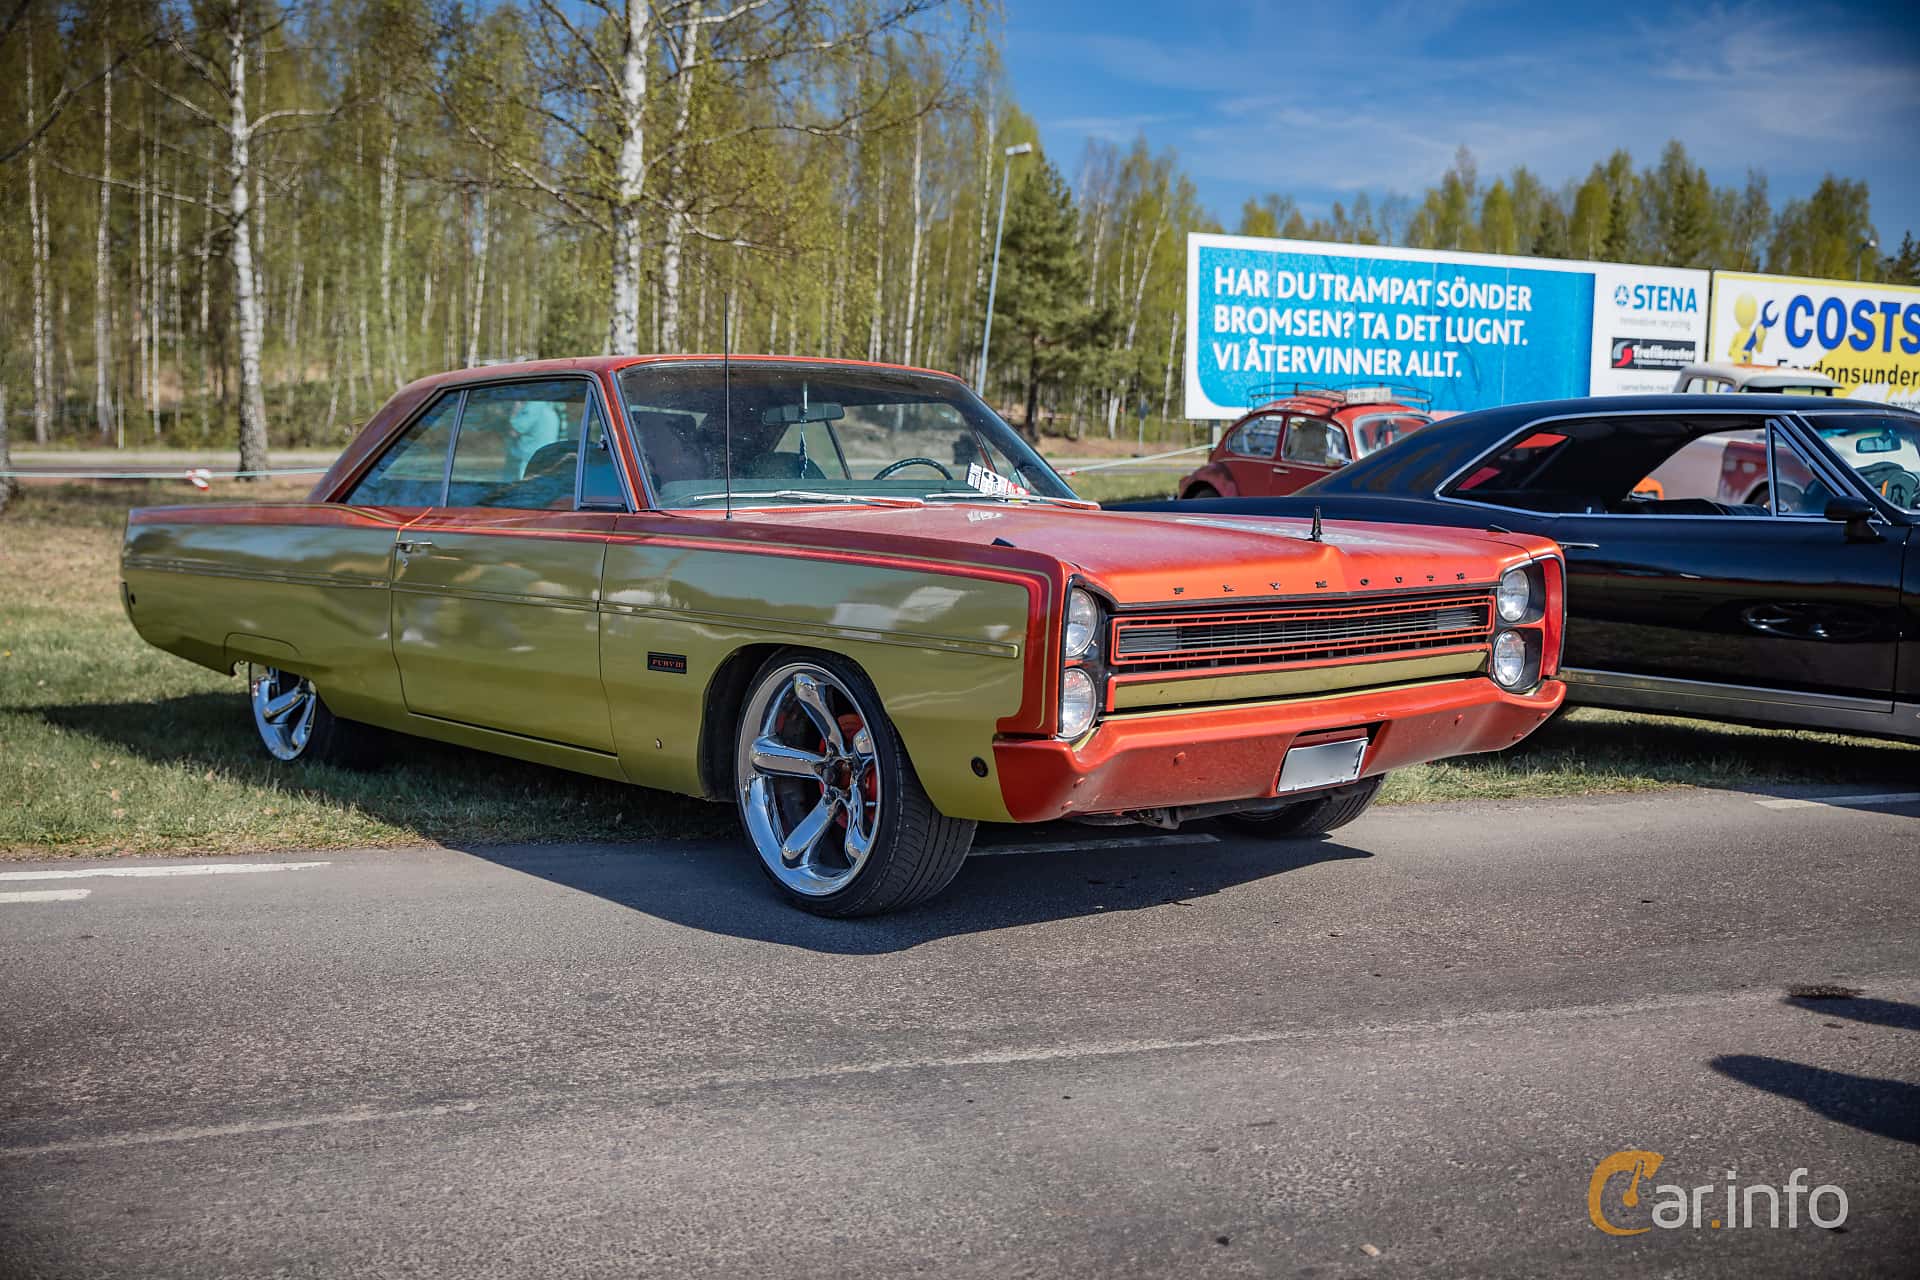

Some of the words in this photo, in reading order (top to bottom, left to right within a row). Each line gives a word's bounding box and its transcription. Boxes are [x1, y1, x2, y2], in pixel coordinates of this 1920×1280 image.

[1214, 267, 1270, 297] HAR
[1277, 271, 1316, 300] DU
[1319, 273, 1432, 304] TRAMPAT
[1436, 277, 1532, 312] SÖNDER
[1633, 284, 1697, 313] STENA
[1214, 305, 1354, 338] BROMSEN?
[1359, 313, 1390, 340] TA
[1395, 314, 1441, 343] DET
[1445, 317, 1528, 346] LUGNT.
[1213, 342, 1240, 372] VI
[1244, 338, 1402, 376] ÅTERVINNER
[1406, 350, 1462, 378] ALLT.
[1173, 573, 1466, 595] PLYMOUTH
